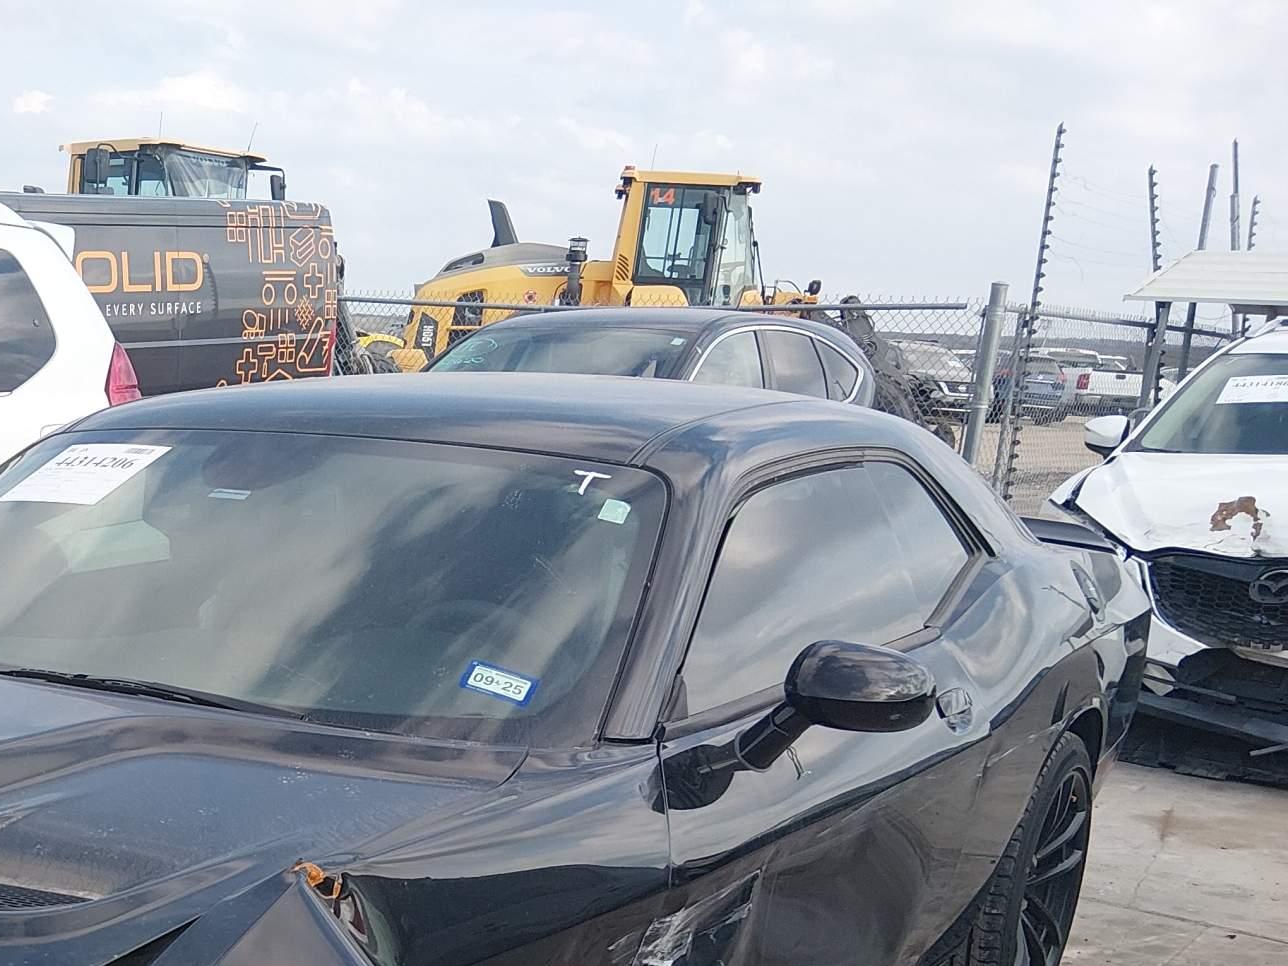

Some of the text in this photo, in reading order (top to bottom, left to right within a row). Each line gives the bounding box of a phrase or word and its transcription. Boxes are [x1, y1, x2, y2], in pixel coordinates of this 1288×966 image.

[650, 187, 675, 205] 14
[105, 301, 202, 317] EVERY SURFACE
[573, 469, 612, 496] T
[473, 672, 524, 695] 09 25
